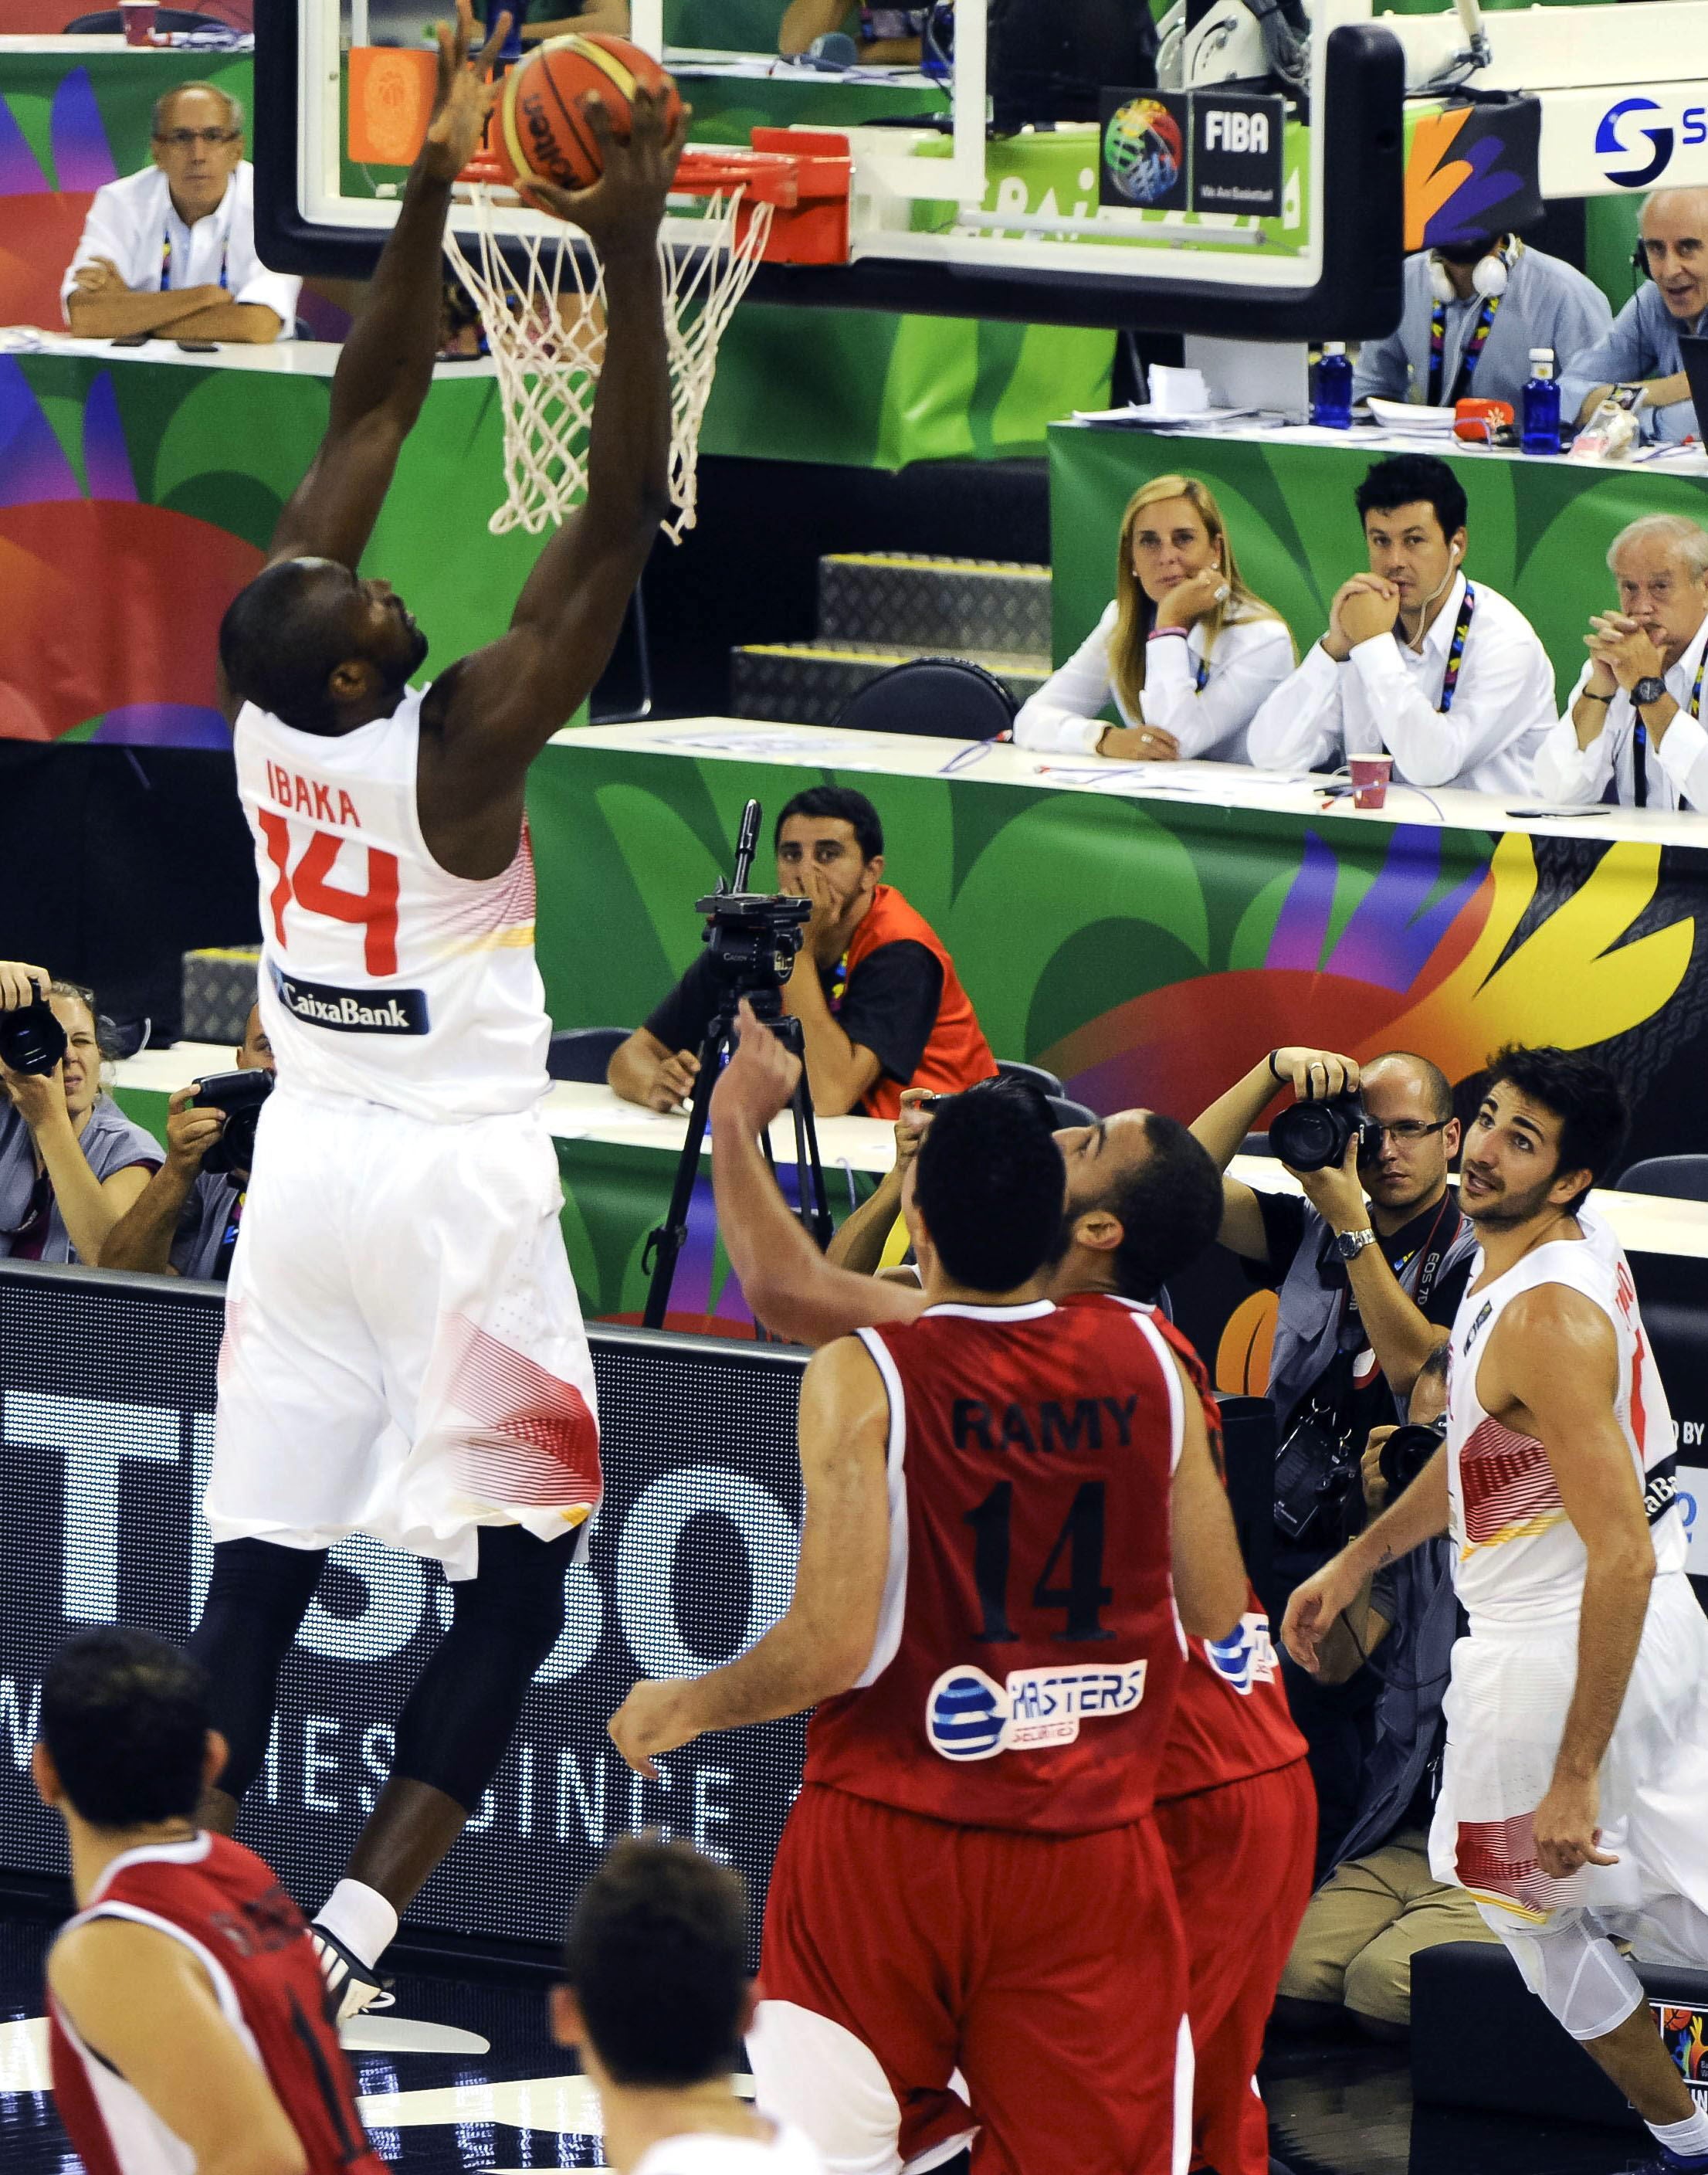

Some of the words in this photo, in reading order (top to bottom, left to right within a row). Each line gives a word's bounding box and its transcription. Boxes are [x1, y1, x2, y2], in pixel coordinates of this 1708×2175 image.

[1205, 110, 1269, 154] FIBA
[266, 758, 361, 828] IBAKA
[259, 806, 399, 977] 14
[284, 985, 410, 1027] CaixaBank
[1422, 1252, 1440, 1284] EOS
[1417, 1288, 1429, 1305] 7D
[953, 1395, 1138, 1453] RAMY
[1683, 1421, 1705, 1446] BY
[963, 1481, 1117, 1644] 14
[1012, 1671, 1141, 1719] MASTERS
